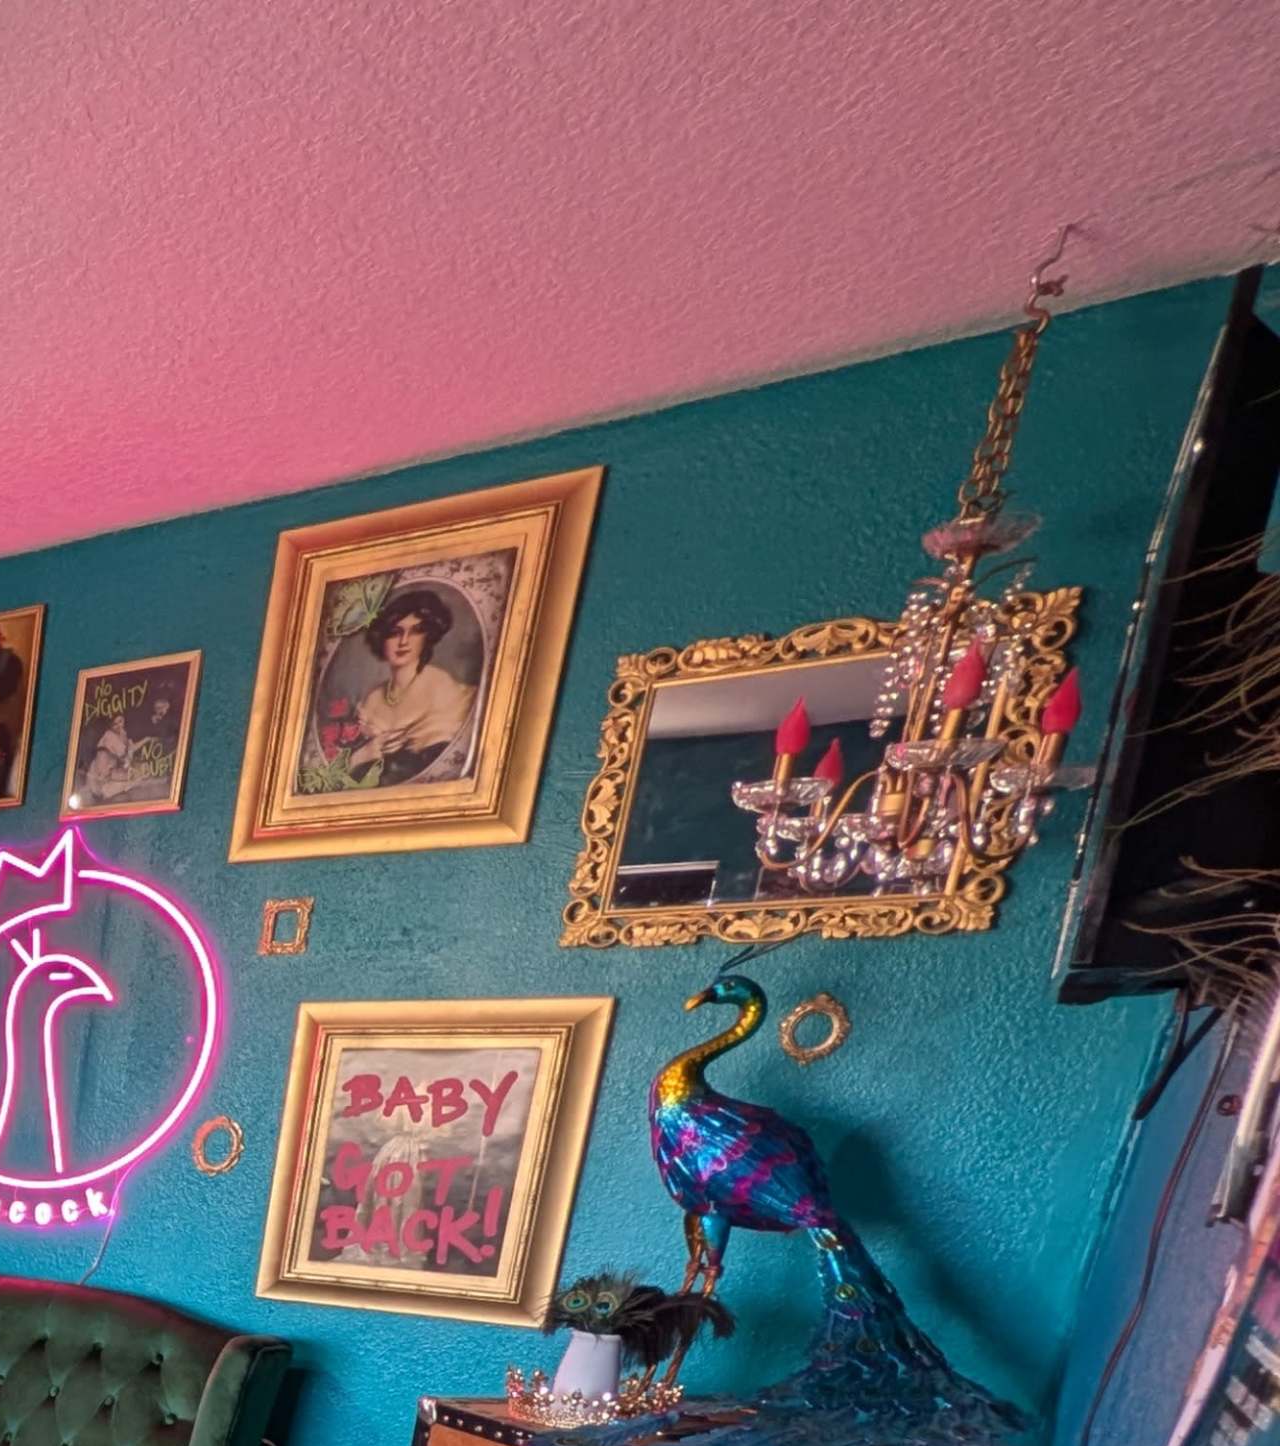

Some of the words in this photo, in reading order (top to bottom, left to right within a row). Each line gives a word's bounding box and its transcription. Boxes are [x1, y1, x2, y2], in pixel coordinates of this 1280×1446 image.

[83, 679, 148, 726] DIGGITY
[341, 1070, 519, 1137] BABY
[332, 1141, 474, 1206] GOT
[319, 1186, 504, 1265] BACK!
